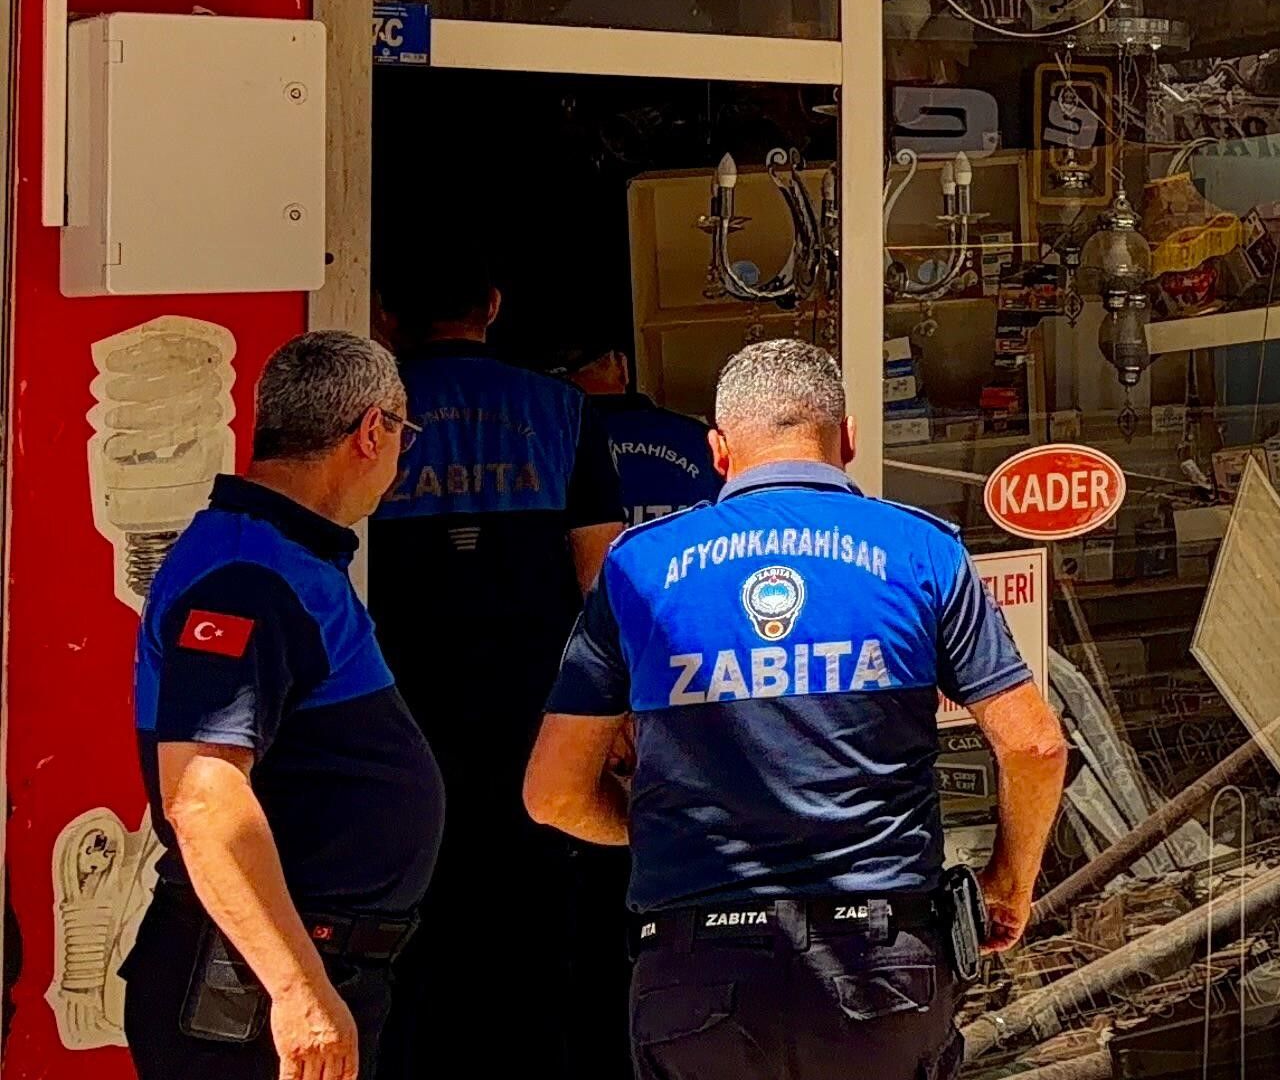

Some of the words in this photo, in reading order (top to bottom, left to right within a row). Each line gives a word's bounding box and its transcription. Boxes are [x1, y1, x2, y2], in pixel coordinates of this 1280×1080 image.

[1000, 470, 1110, 515] KADER
[664, 526, 887, 589] AFYONKARAHİSAR
[669, 639, 892, 706] ZABITA
[706, 911, 768, 927] ZABITA
